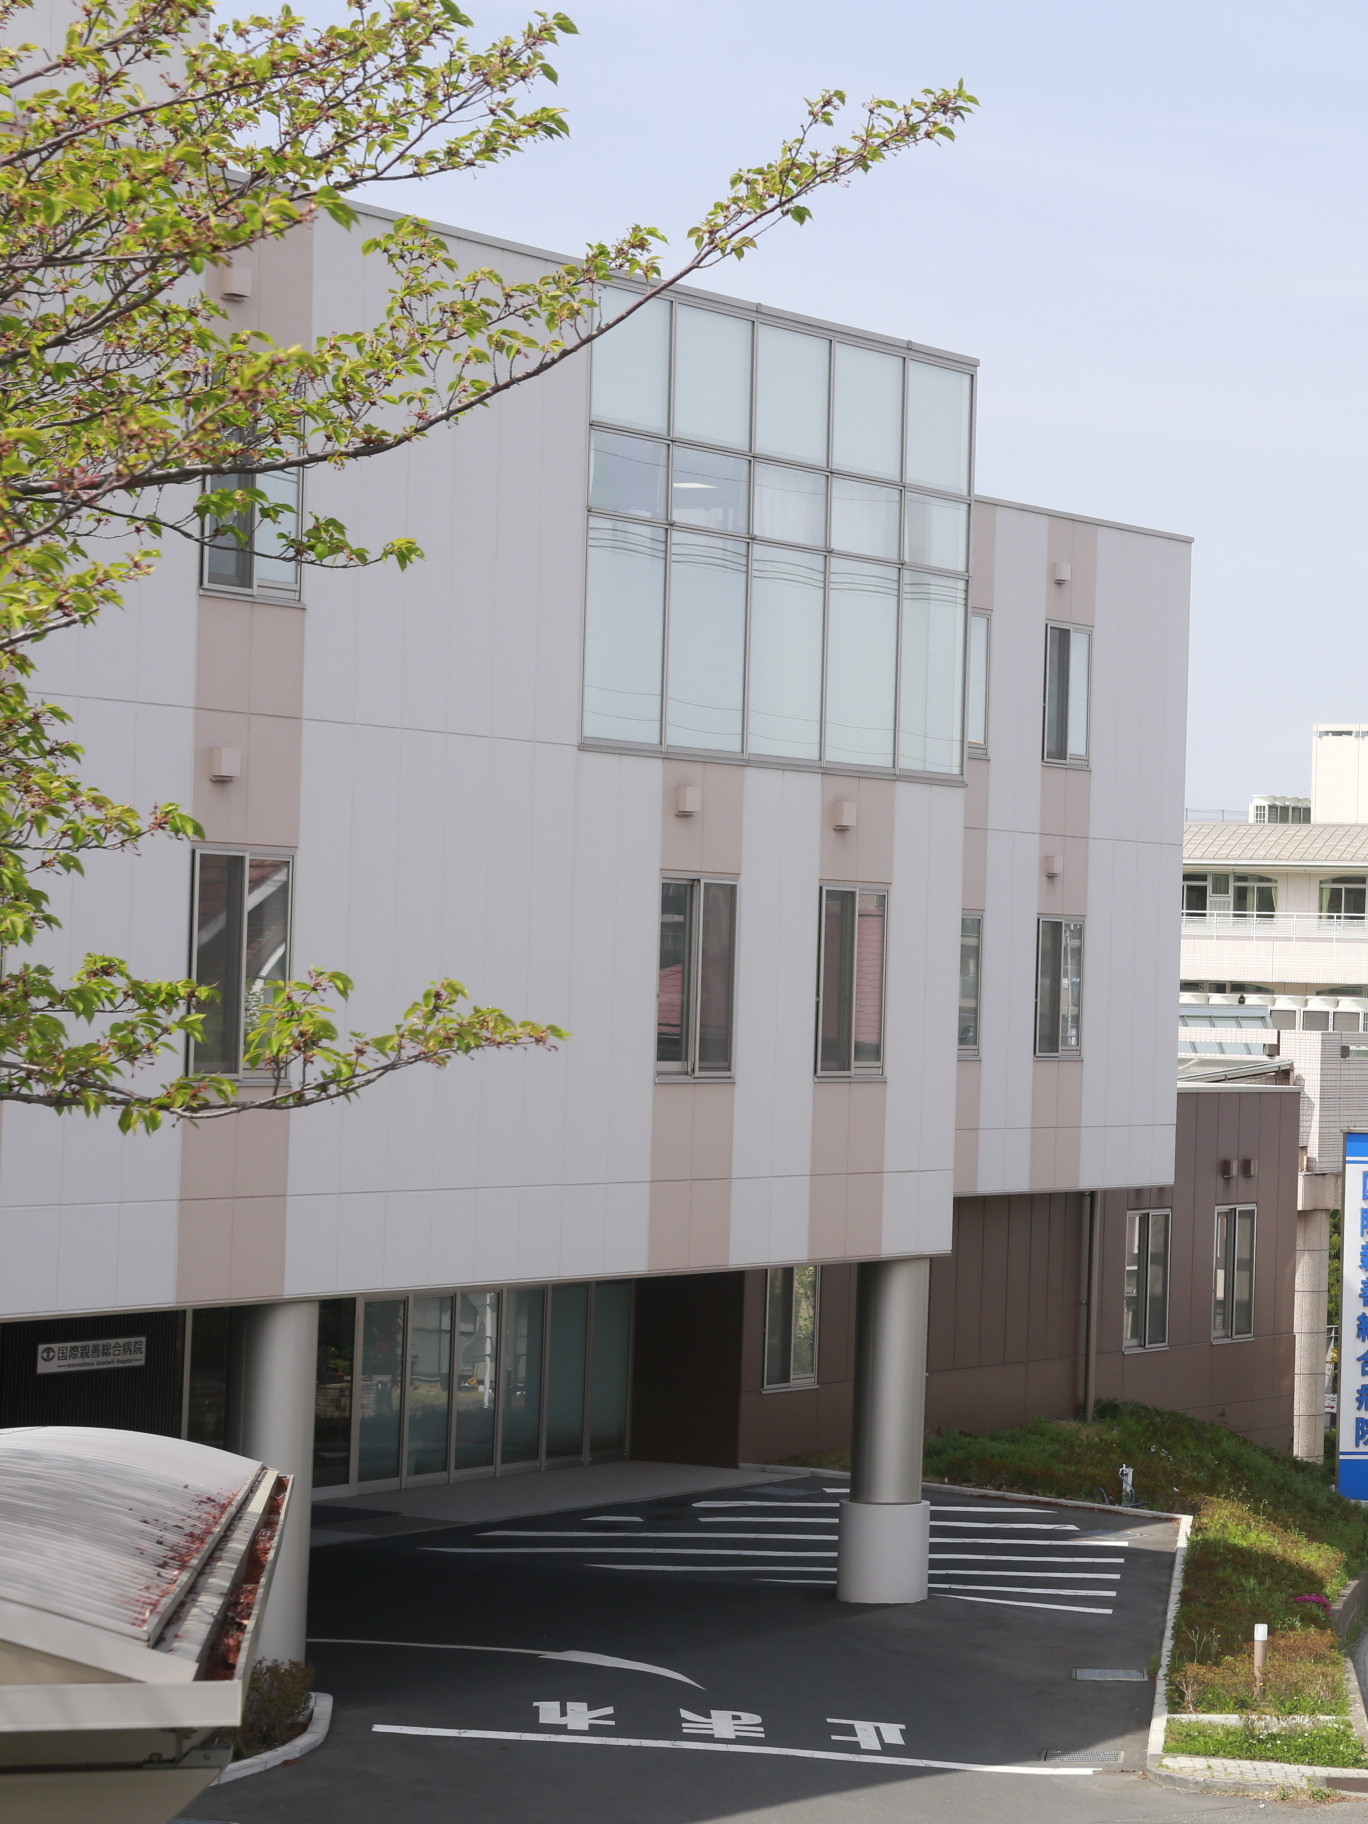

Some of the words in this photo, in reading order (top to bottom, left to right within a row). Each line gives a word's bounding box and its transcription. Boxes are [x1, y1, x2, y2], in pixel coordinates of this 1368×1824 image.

[57, 1340, 144, 1361] 国際親善総合病院
